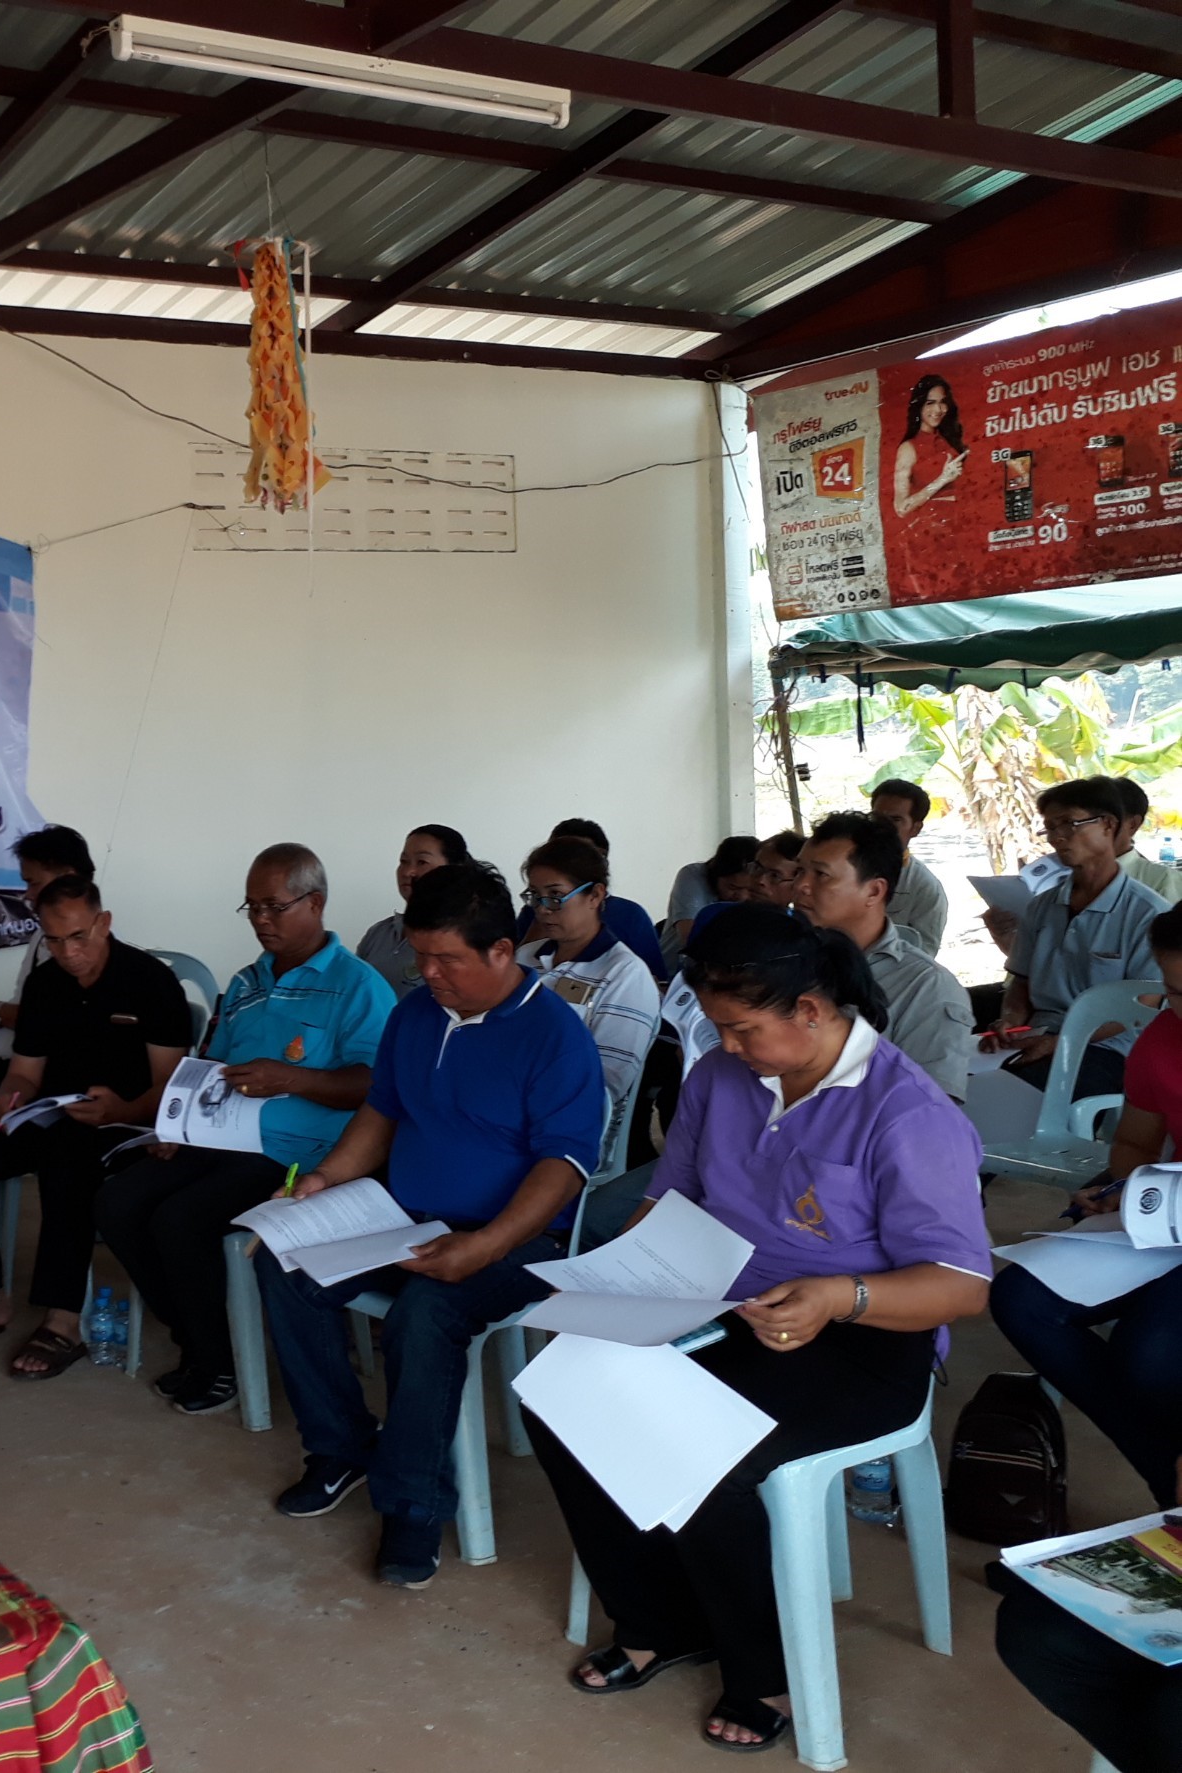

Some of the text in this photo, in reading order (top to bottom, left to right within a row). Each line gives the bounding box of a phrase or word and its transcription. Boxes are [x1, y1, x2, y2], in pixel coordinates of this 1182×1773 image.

[1038, 343, 1066, 362] 900
[986, 356, 1111, 404] ย้ายมาทรูมูฟ
[992, 449, 1011, 462] 3G
[776, 470, 804, 496] เปิด
[822, 463, 852, 486] 24
[806, 536, 819, 547] 24
